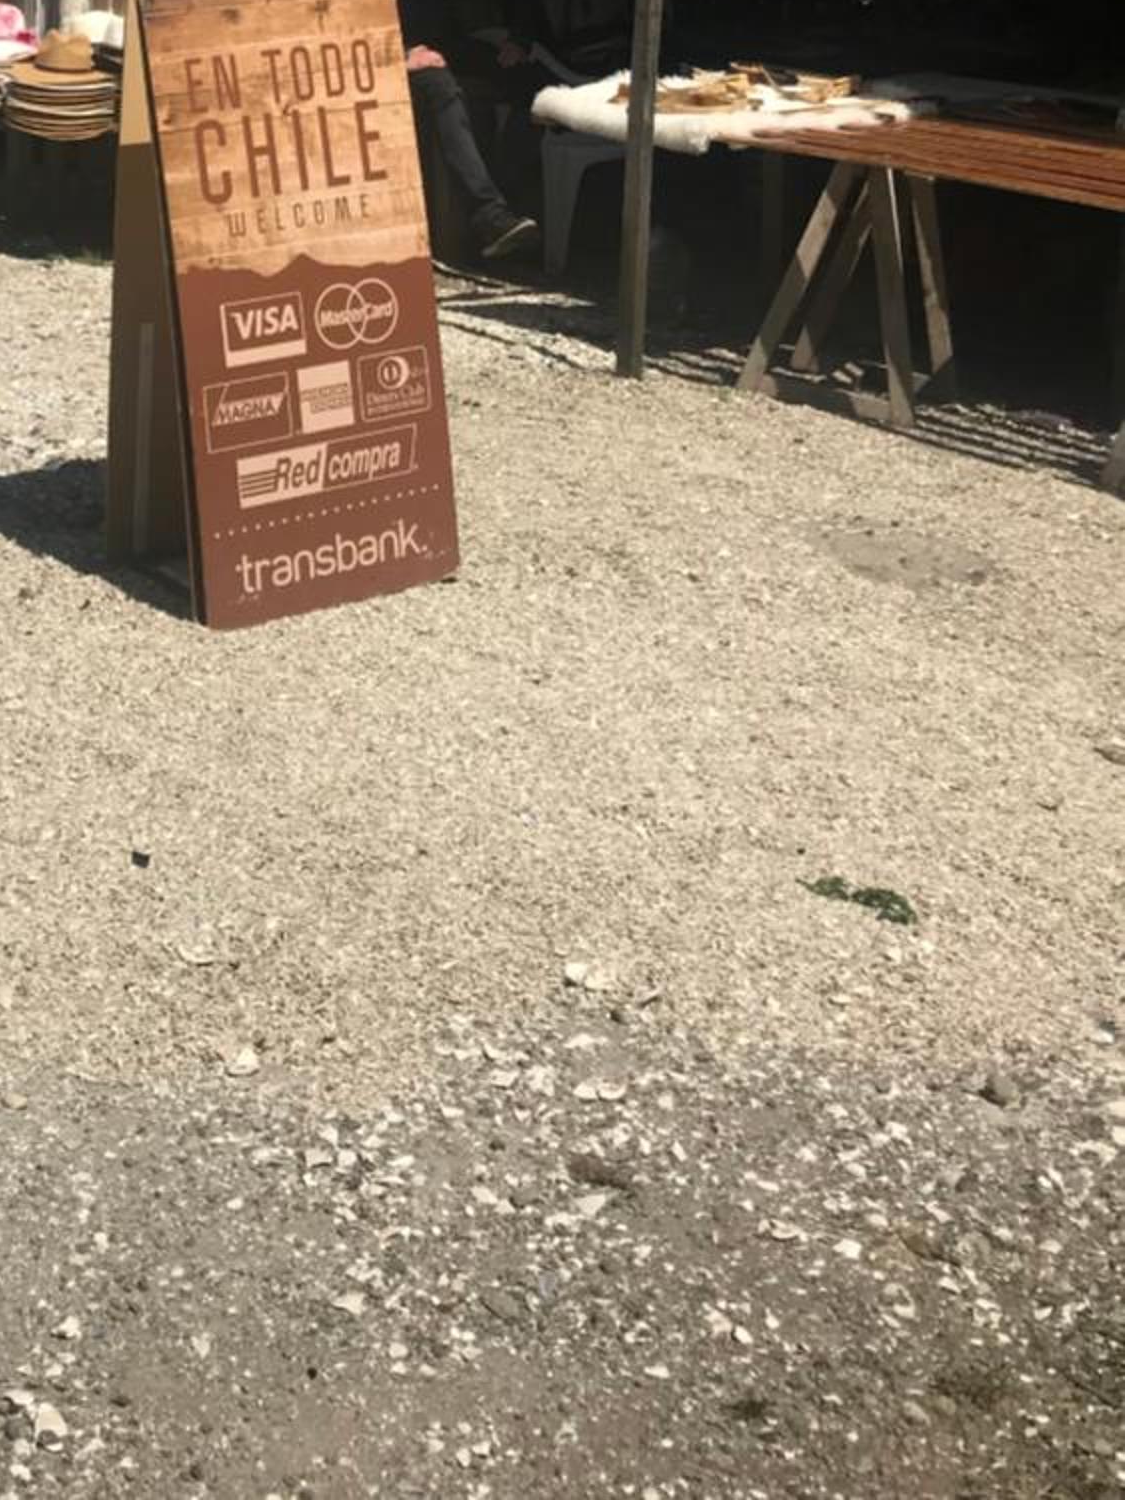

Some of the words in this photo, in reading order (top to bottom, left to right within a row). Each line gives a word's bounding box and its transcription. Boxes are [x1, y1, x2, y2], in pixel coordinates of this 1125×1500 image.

[184, 53, 242, 114] EN
[261, 38, 375, 105] TODO
[194, 100, 388, 205] CHILE
[226, 193, 372, 238] WELCOME
[230, 303, 299, 340] VISA
[275, 449, 323, 491] Red
[328, 441, 401, 482] compra
